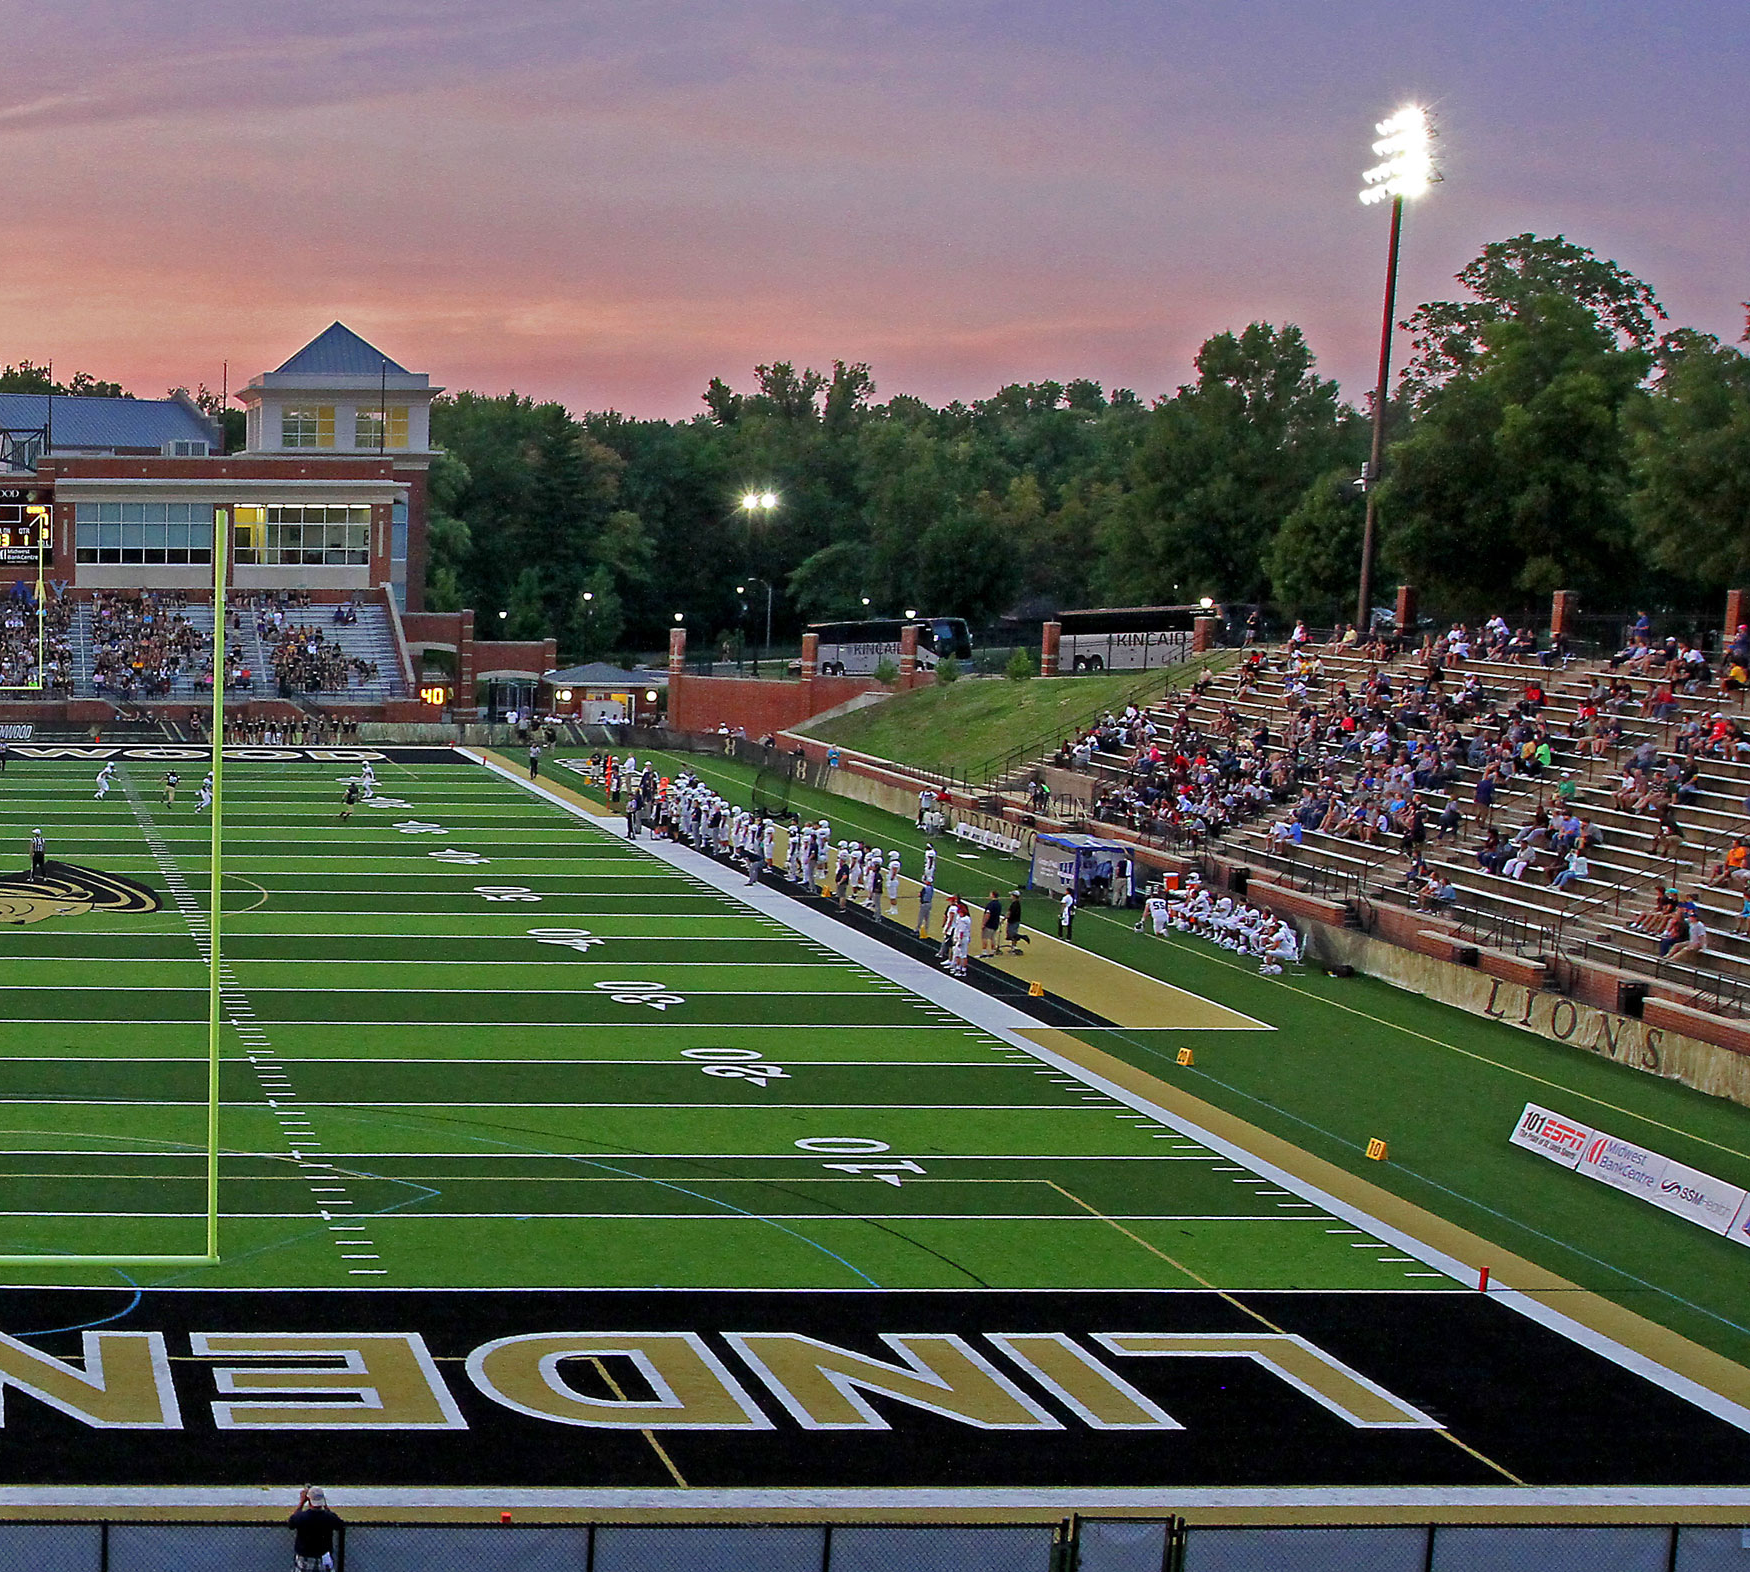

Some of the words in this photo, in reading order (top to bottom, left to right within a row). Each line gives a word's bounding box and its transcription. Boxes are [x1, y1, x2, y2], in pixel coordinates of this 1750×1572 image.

[19, 527, 31, 535] QTR
[1116, 632, 1186, 647] KINCAID
[421, 687, 444, 704] 40
[473, 886, 543, 902] 50
[526, 928, 606, 947] 40
[593, 981, 686, 1004] 30
[1484, 978, 1664, 1069] LIONS
[680, 1048, 793, 1077] 20
[1521, 1111, 1546, 1133] 101
[1541, 1119, 1587, 1151] ESPN
[794, 1137, 927, 1174] 10
[1369, 1141, 1381, 1156] 10
[1606, 1140, 1648, 1167] Midwest
[1599, 1155, 1655, 1188] BankCentre
